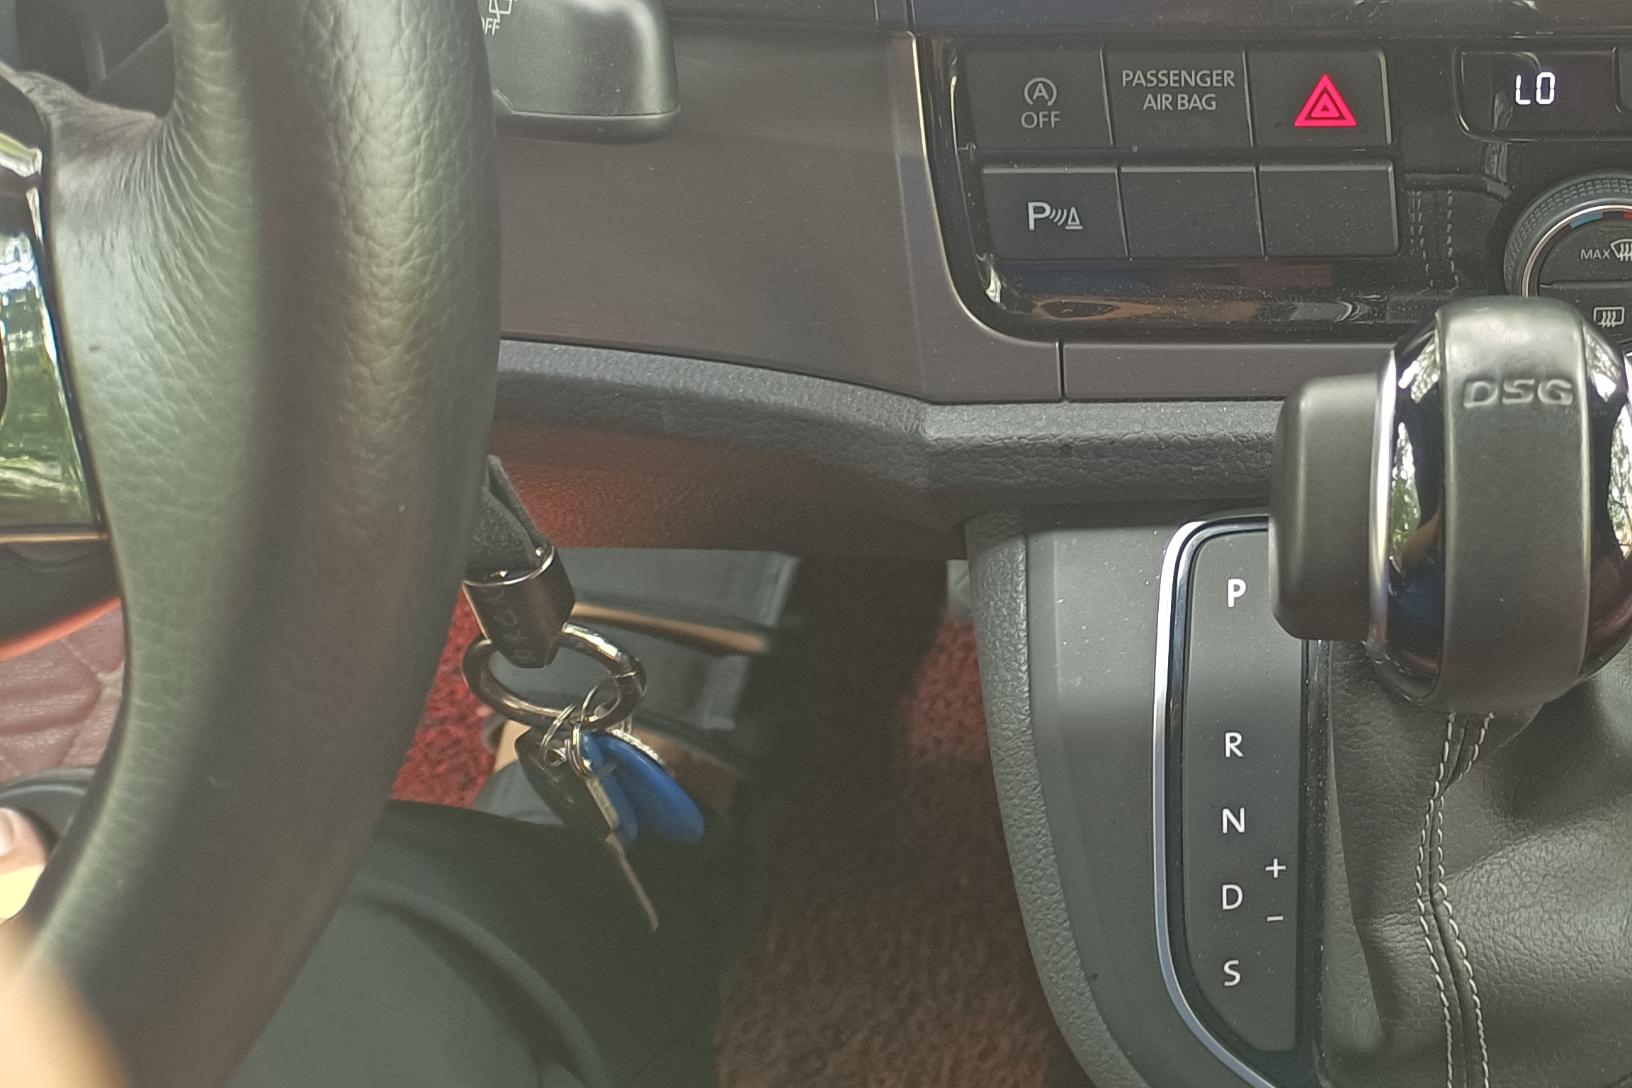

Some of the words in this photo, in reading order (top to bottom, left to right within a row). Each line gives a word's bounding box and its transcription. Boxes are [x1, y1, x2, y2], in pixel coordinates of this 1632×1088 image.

[1121, 69, 1236, 89] PASSENGER
[1142, 93, 1174, 112] AIR
[1177, 93, 1217, 112] BAG
[1020, 111, 1060, 129] OFF
[1580, 247, 1611, 261] MAX
[1463, 378, 1573, 409] DSG
[1226, 578, 1247, 608] P
[1224, 731, 1244, 758] R
[1222, 808, 1246, 834] N
[1222, 884, 1244, 910] D
[1223, 959, 1242, 987] S
